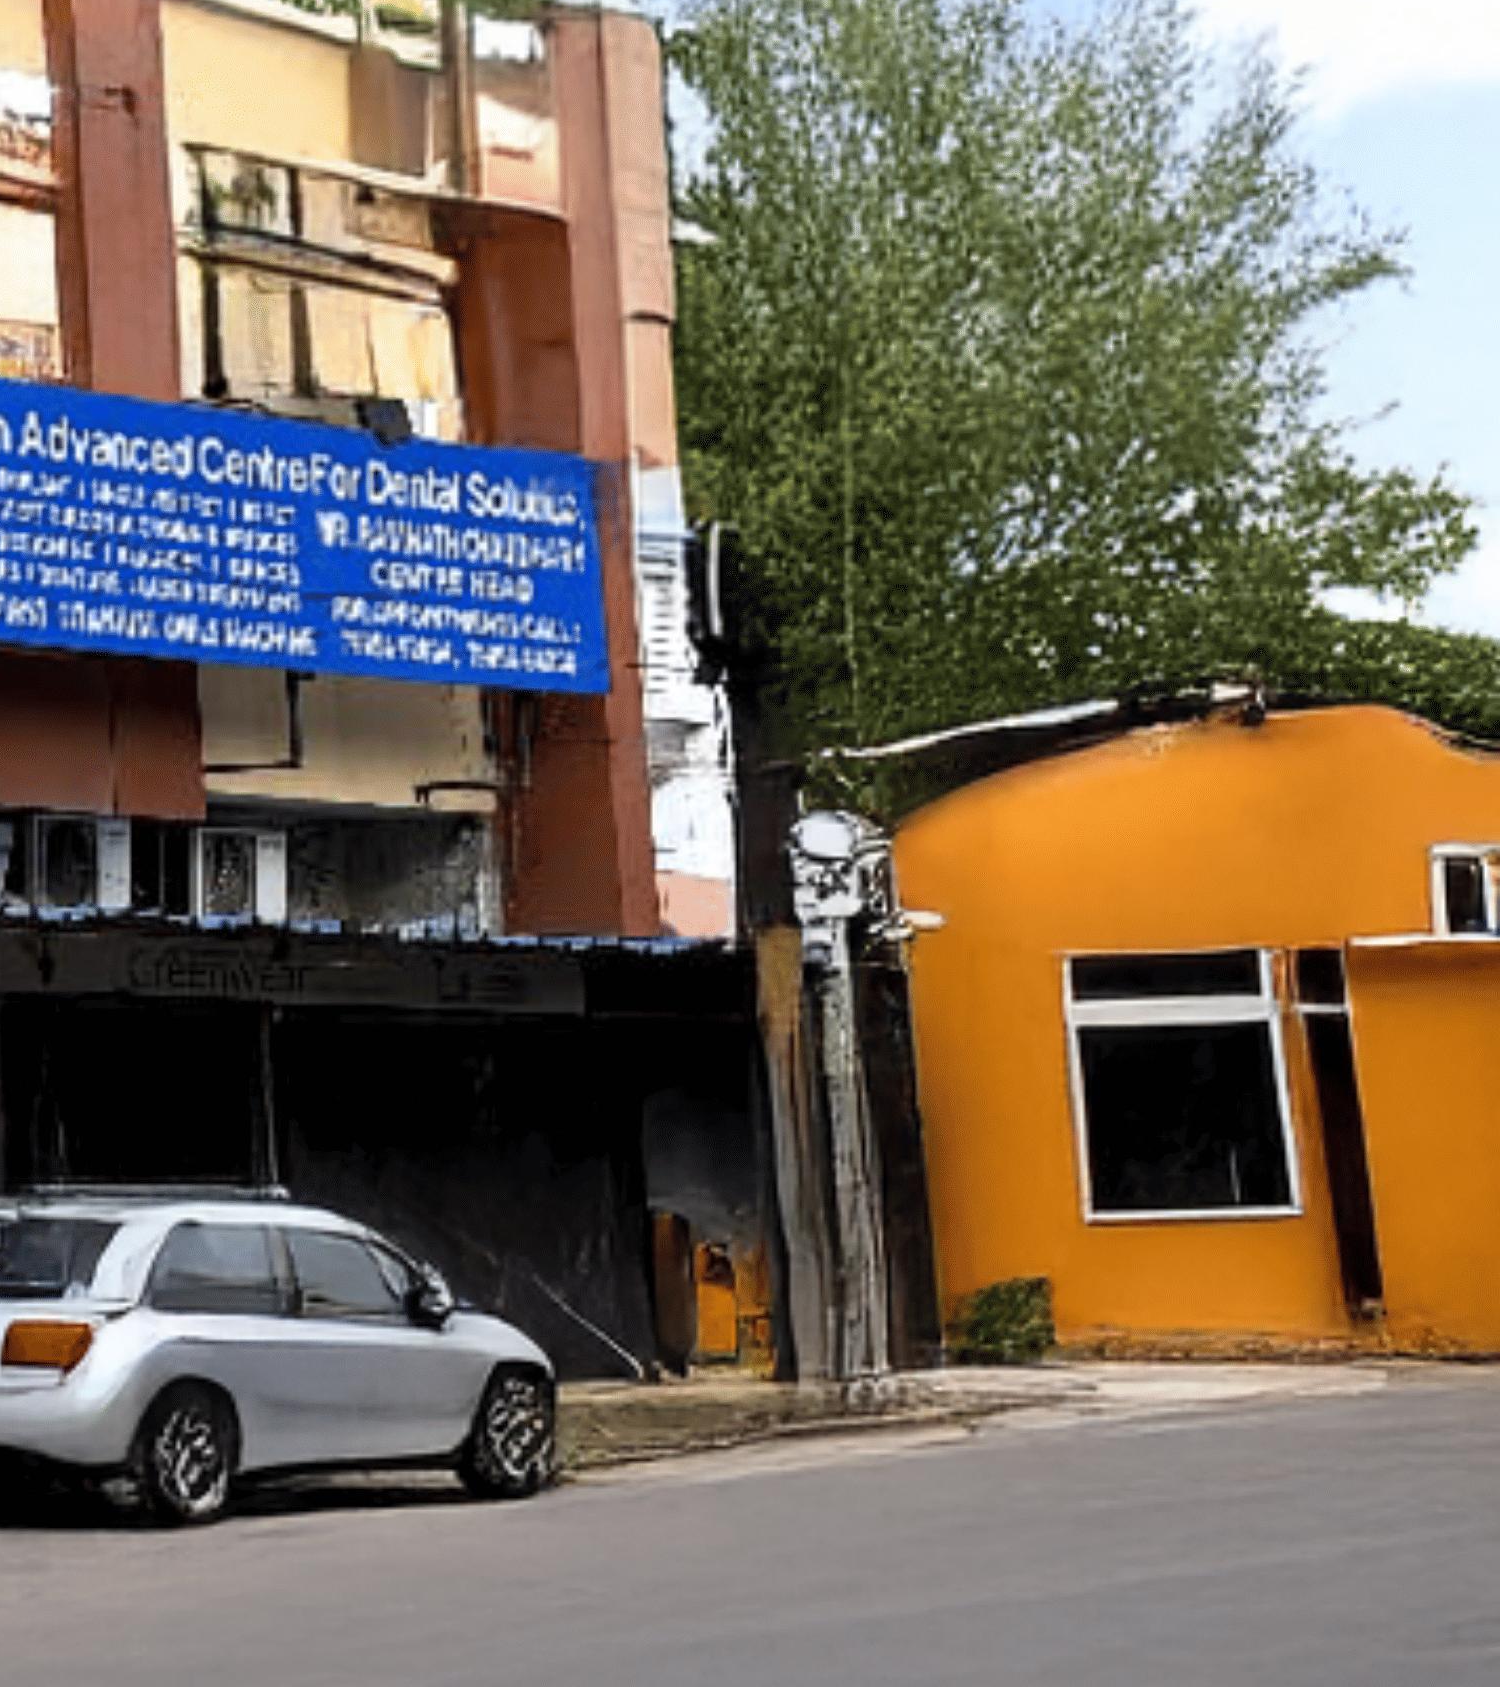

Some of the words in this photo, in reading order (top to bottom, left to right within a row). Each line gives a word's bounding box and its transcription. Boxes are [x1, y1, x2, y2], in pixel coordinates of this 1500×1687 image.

[19, 410, 195, 479] Advanced
[199, 437, 308, 493] Centre
[366, 460, 461, 513] Dental
